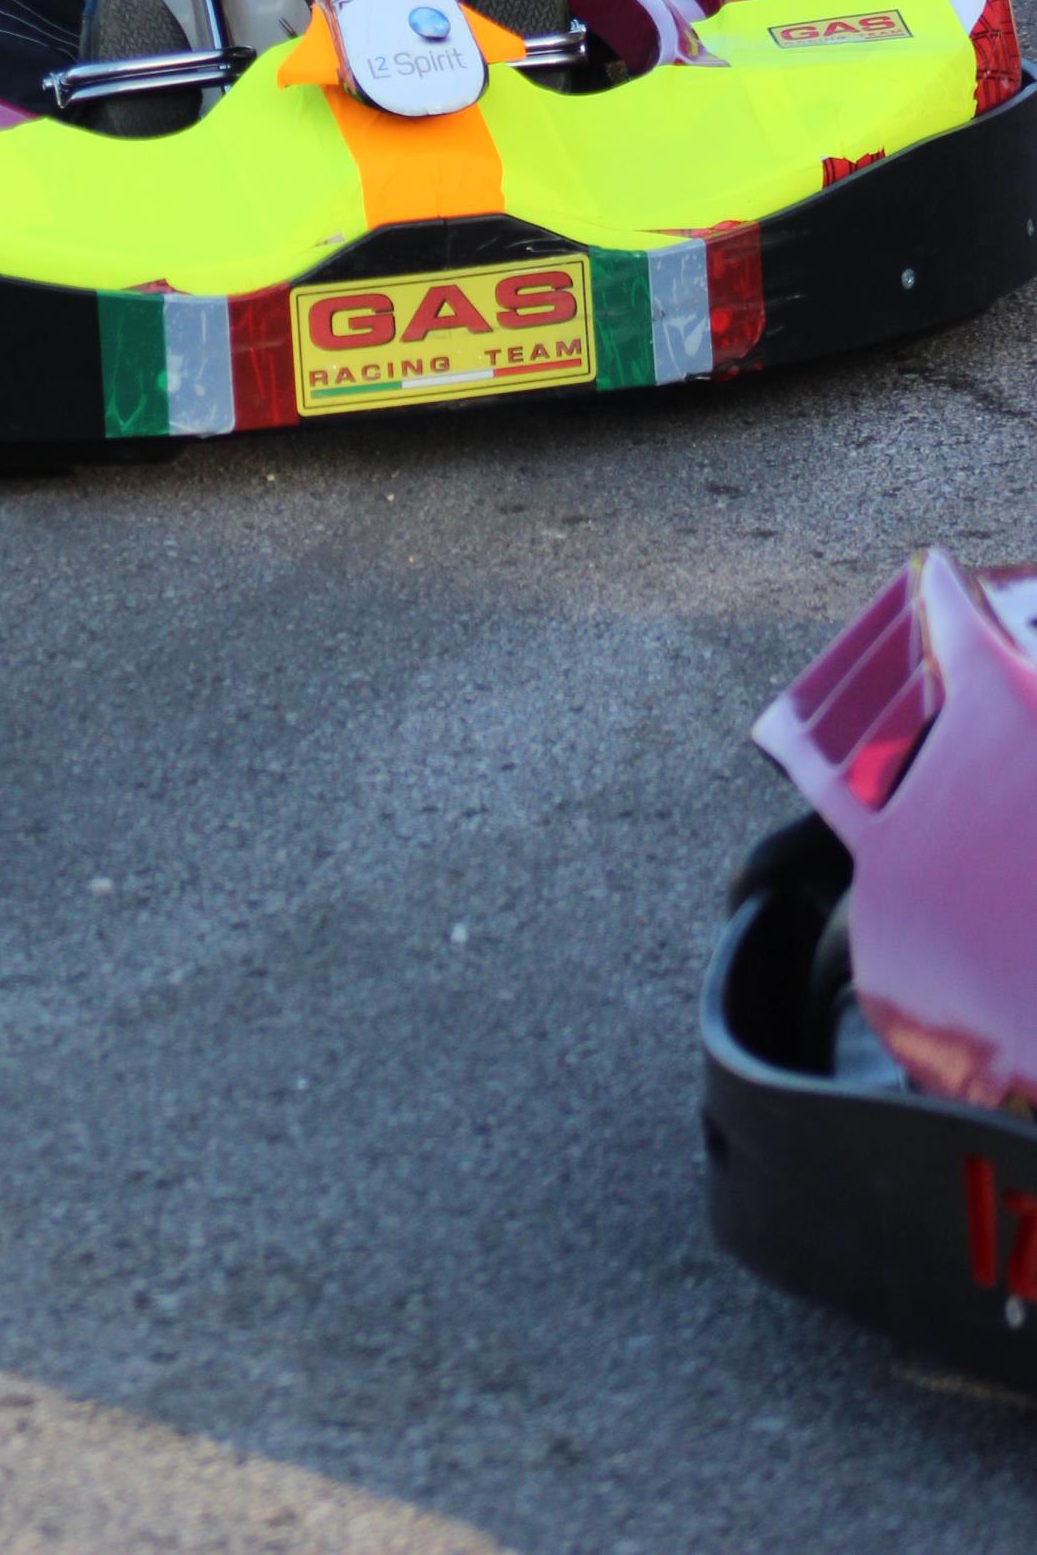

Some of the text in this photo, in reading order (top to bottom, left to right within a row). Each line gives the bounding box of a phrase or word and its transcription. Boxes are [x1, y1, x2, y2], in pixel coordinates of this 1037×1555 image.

[780, 15, 896, 41] GAS
[393, 47, 468, 80] Spirit
[308, 270, 578, 351] GAS
[309, 337, 583, 388] RACING TEAM
